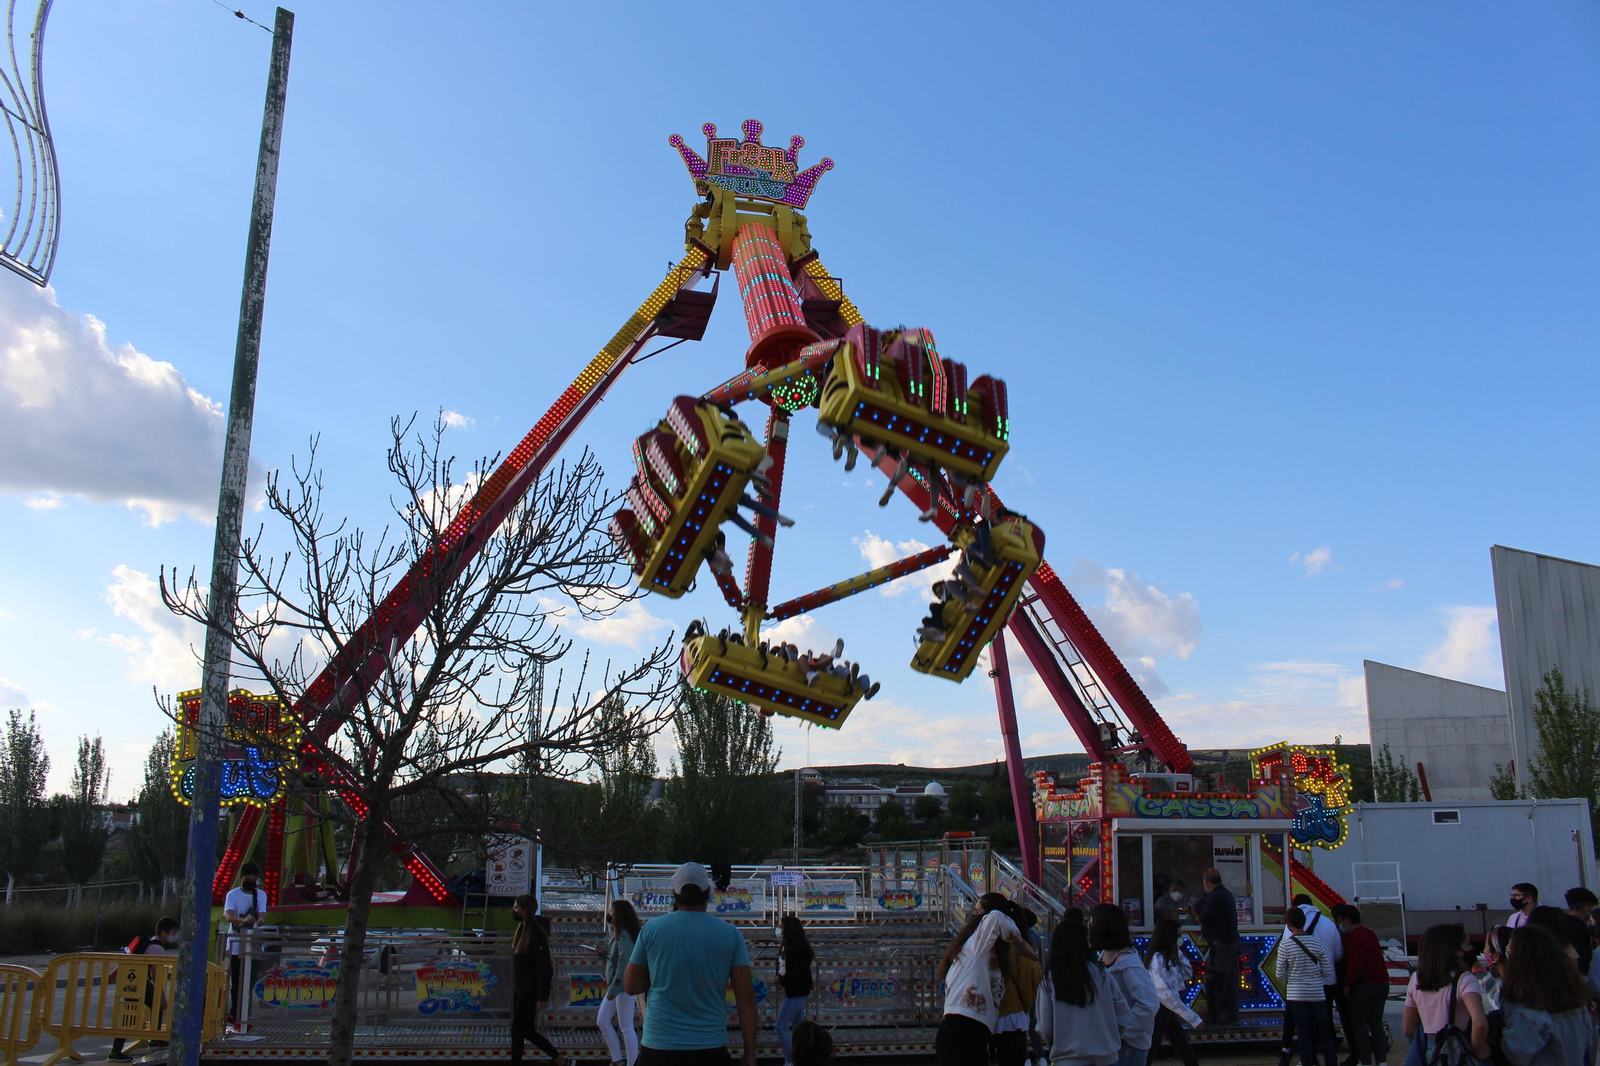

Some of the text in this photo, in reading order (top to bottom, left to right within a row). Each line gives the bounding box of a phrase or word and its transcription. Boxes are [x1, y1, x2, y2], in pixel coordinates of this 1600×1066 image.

[709, 139, 795, 182] Freak
[1044, 795, 1089, 818] CASSA
[1138, 798, 1257, 817] CASSA
[493, 885, 525, 894] TILOS!!!
[804, 893, 847, 907] EXTREME
[883, 894, 918, 908] XXL
[415, 967, 490, 1001] Freak
[851, 978, 894, 997] PEREZ
